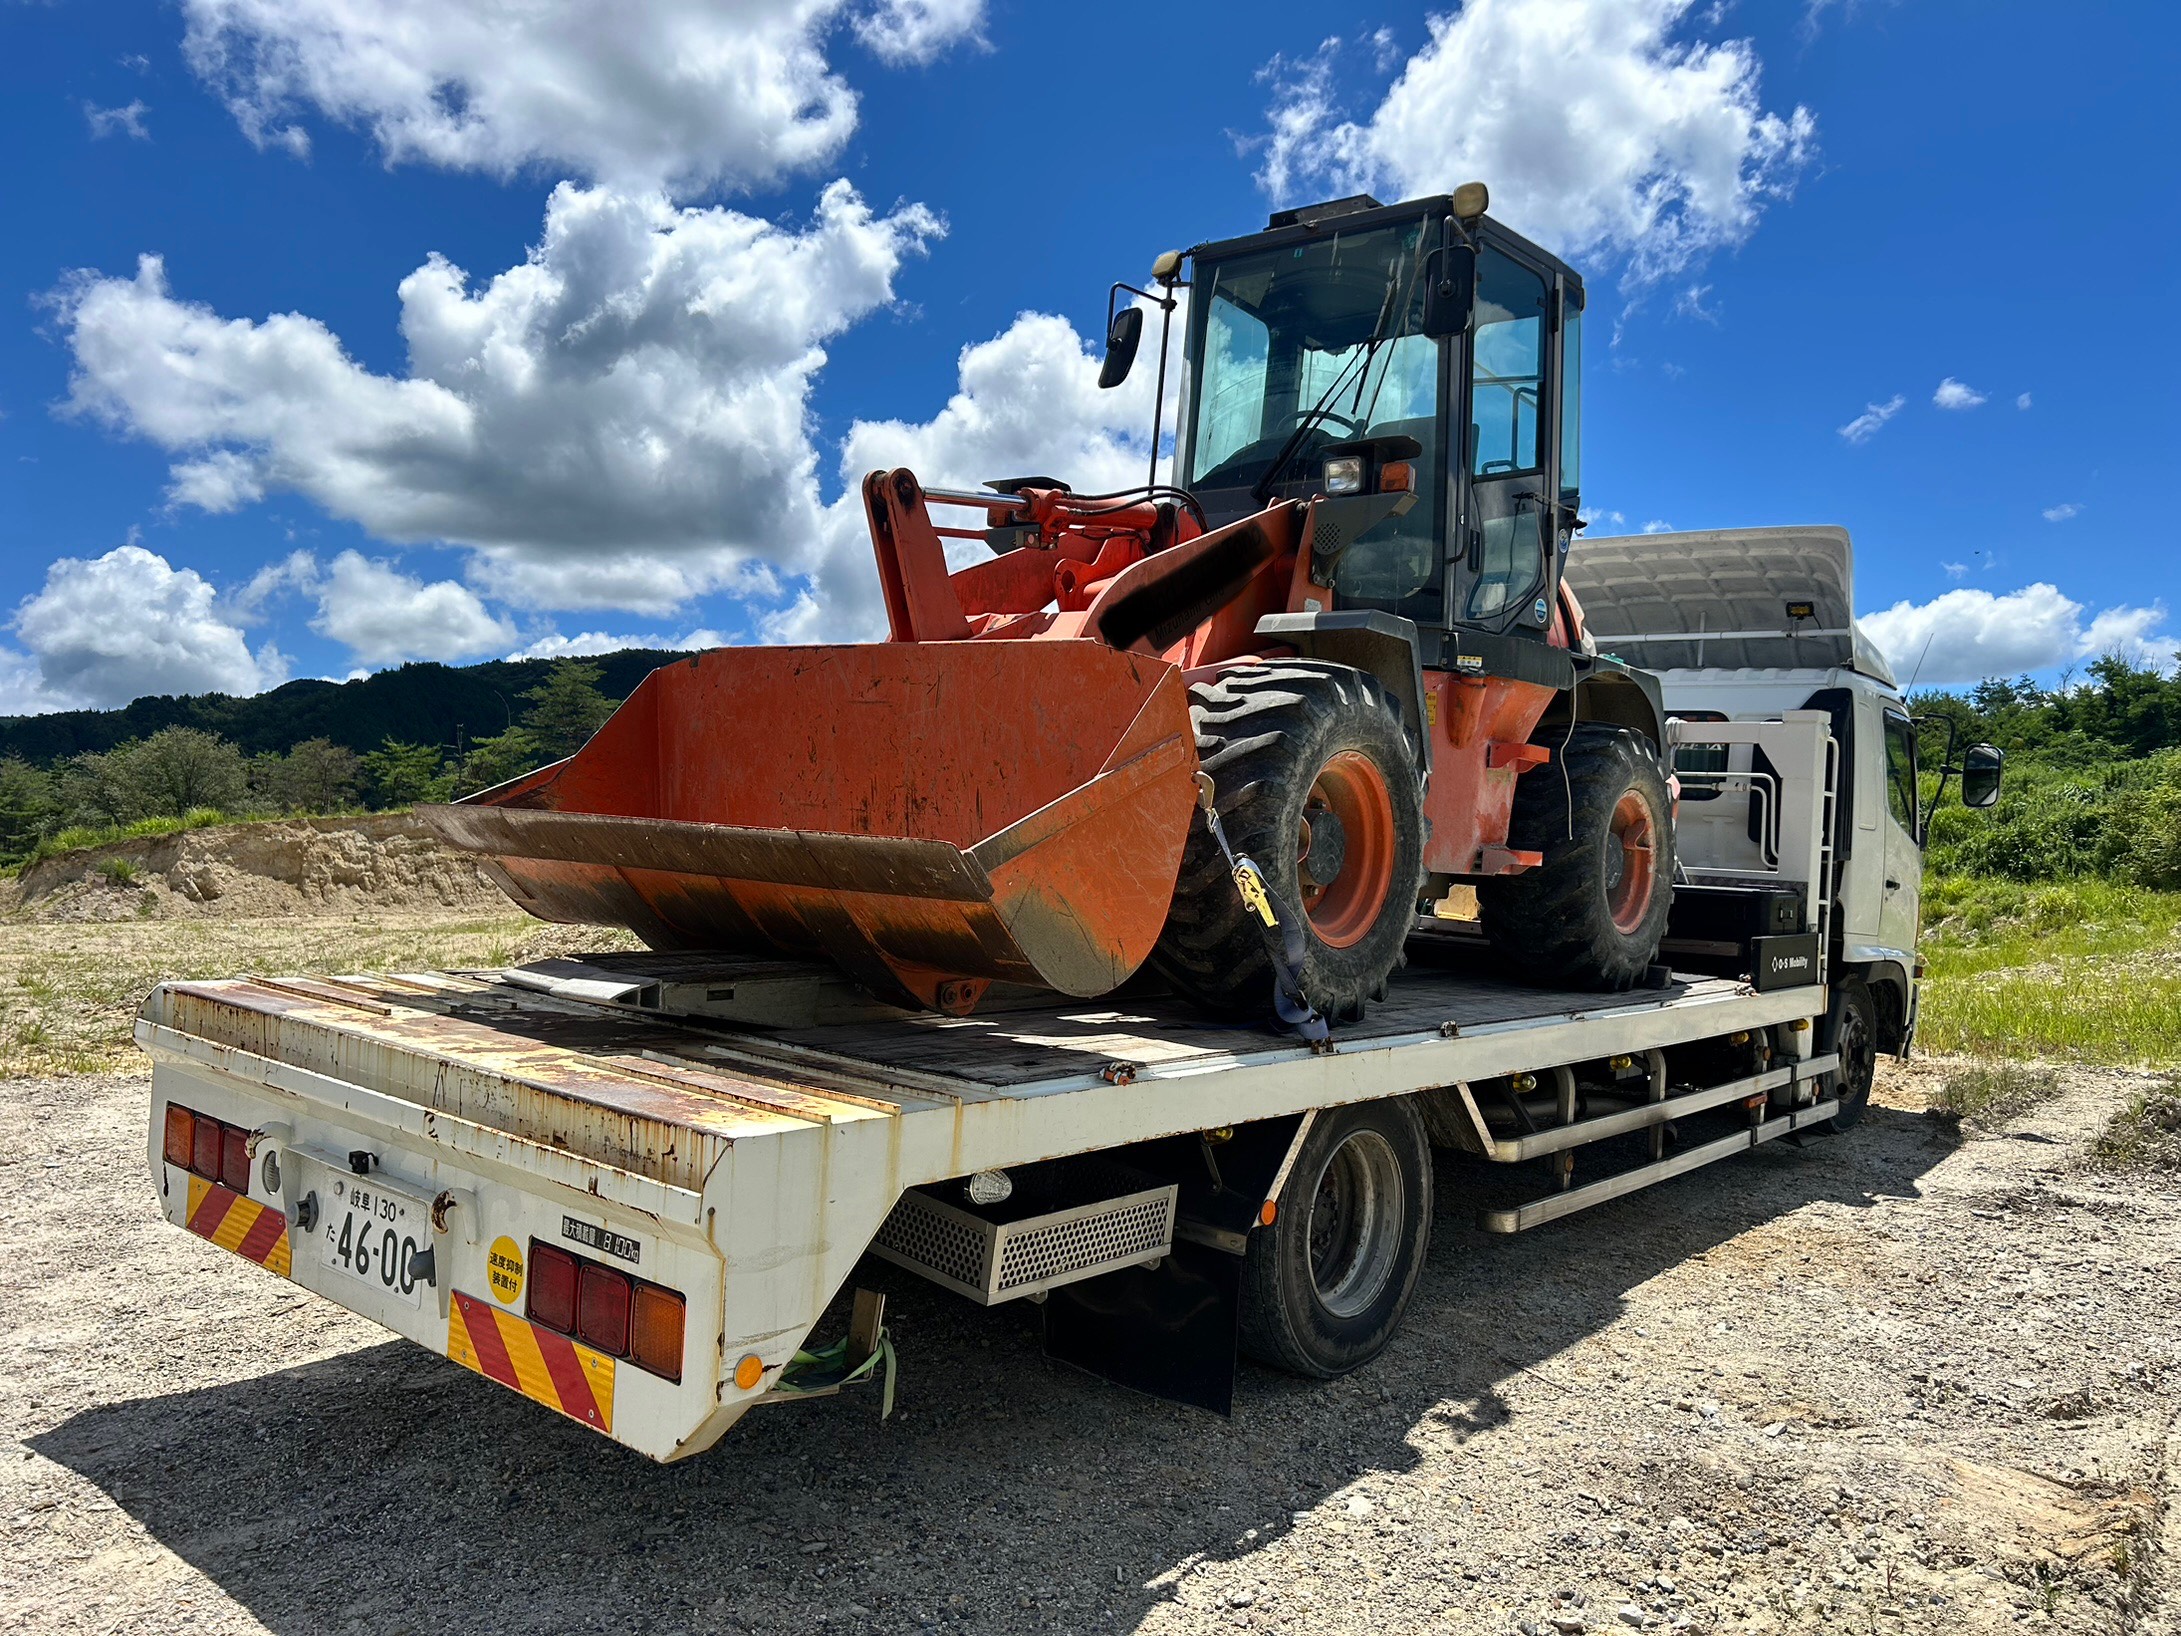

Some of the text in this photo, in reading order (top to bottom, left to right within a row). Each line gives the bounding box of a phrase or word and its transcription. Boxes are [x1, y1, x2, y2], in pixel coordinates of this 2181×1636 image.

[1789, 956, 1808, 969] Mobility
[350, 1187, 397, 1223] 岐阜 130
[325, 1223, 336, 1243] た
[562, 1218, 597, 1246] 最大積載量
[489, 1252, 524, 1278] 速度抑制
[492, 1270, 518, 1294] 装置付
